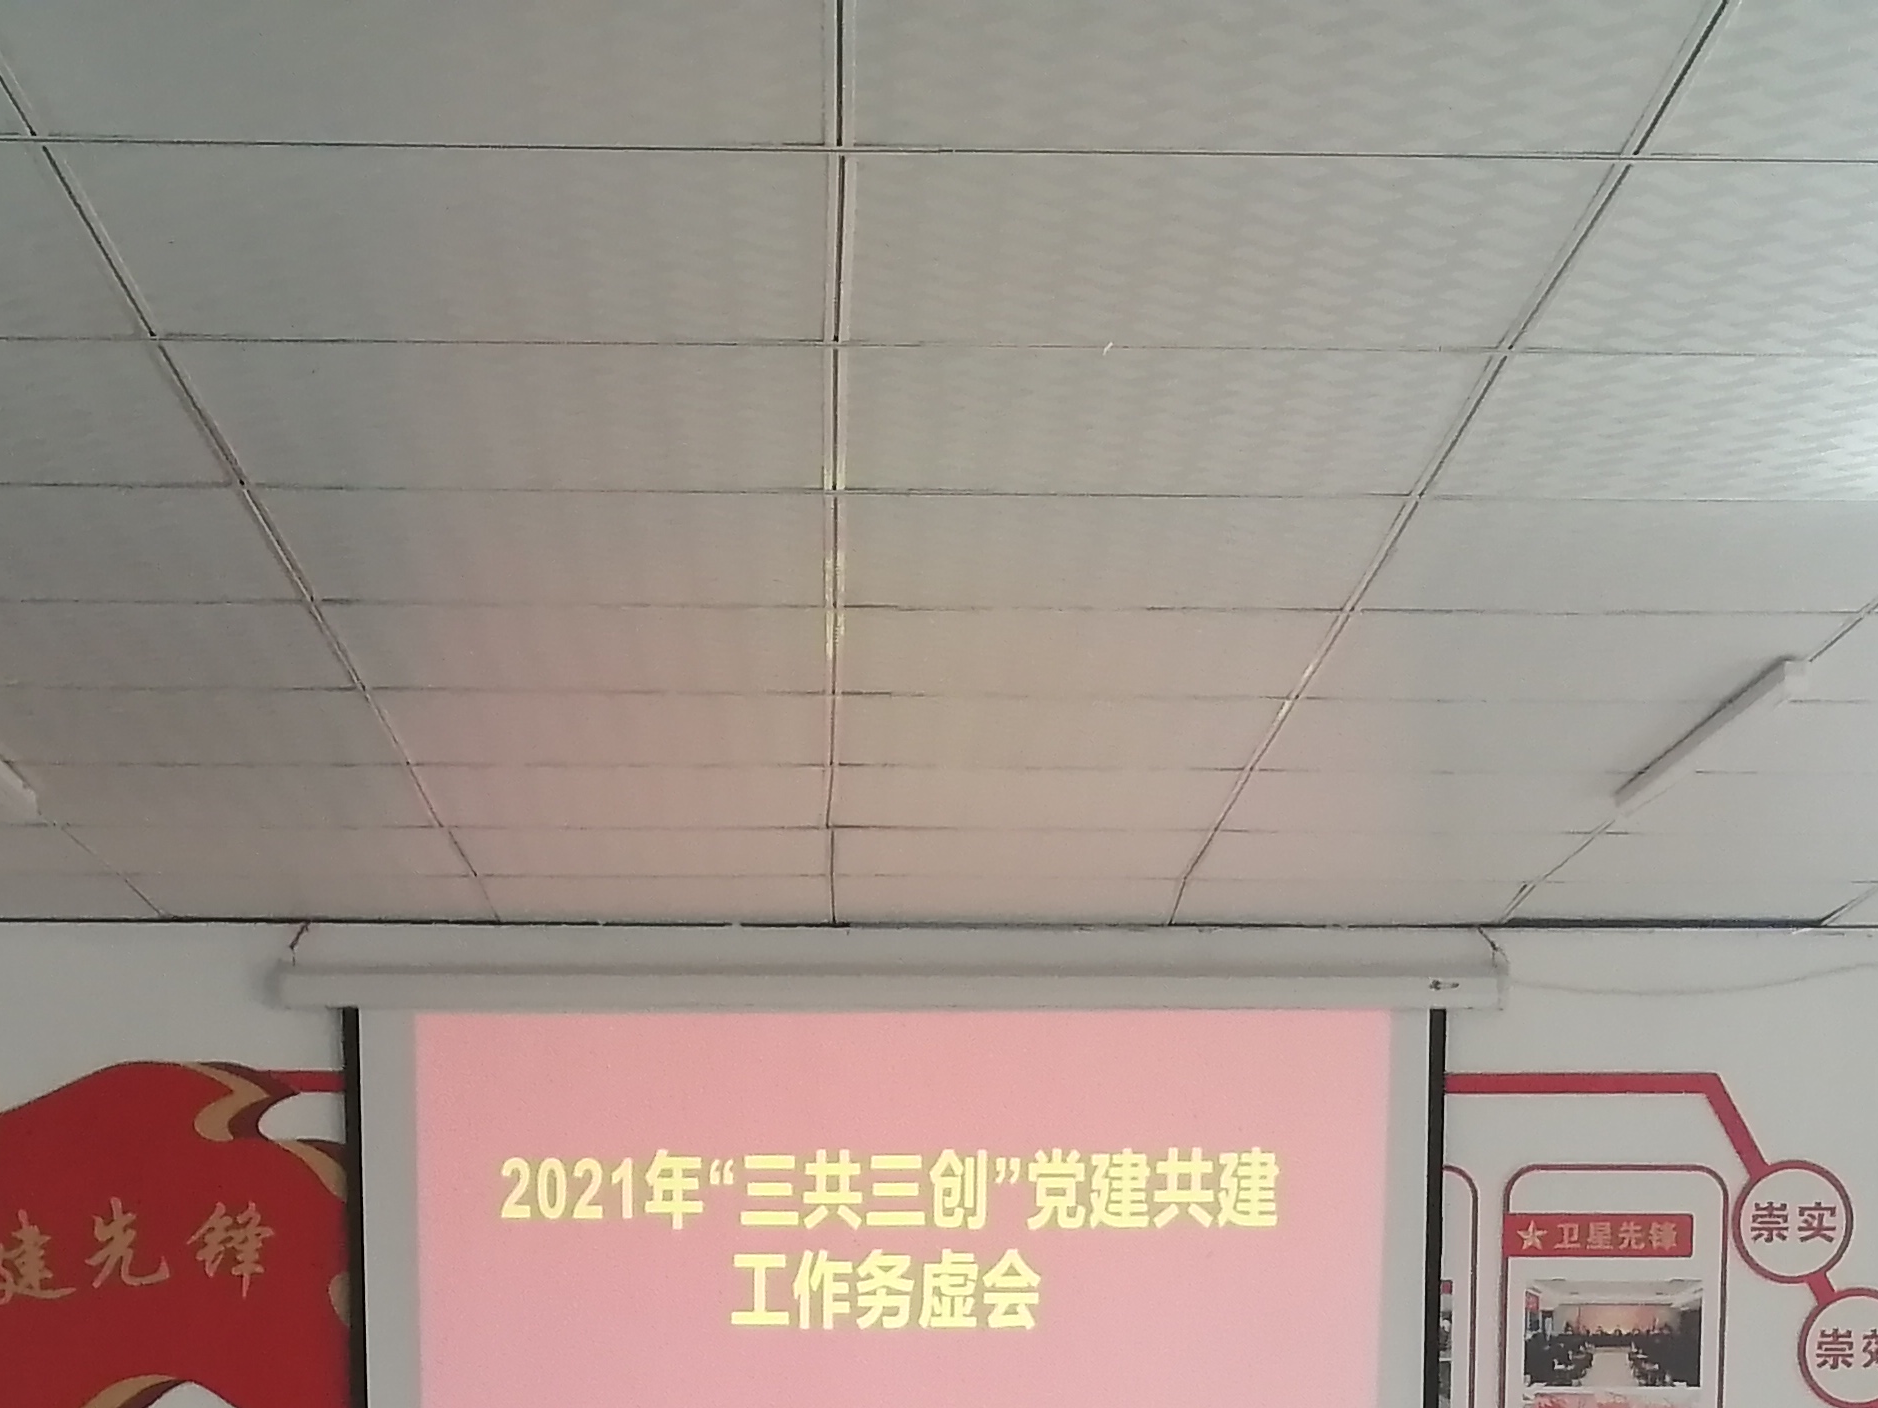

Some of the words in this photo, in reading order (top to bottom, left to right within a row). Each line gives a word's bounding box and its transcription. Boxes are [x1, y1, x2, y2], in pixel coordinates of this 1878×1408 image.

[499, 1148, 1281, 1231] 2021年“三共三创”党建共建
[1553, 1221, 1679, 1252] 卫星先锋
[1749, 1200, 1838, 1244] 崇实
[730, 1248, 1042, 1331] 工作务虚会
